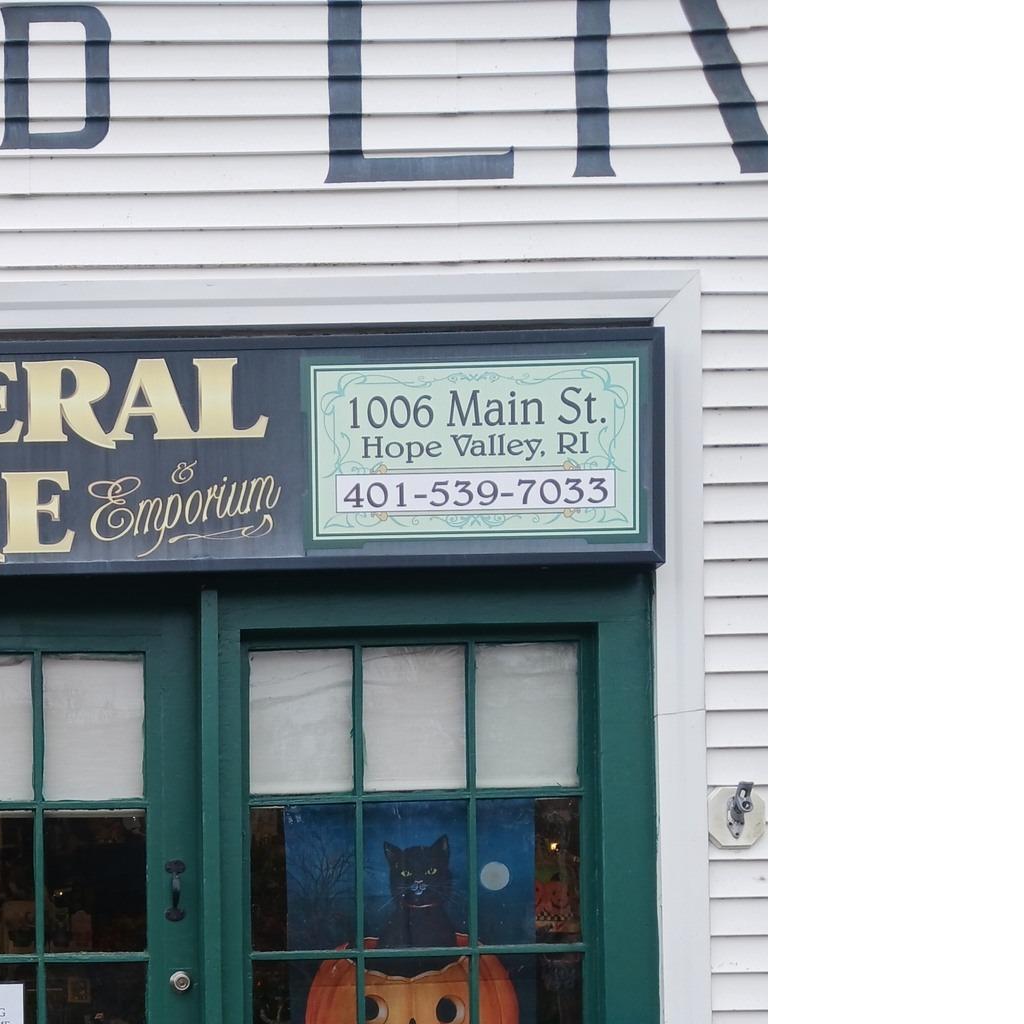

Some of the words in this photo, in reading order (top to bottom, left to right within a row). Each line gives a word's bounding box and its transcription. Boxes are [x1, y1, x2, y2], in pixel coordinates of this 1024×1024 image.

[349, 394, 434, 429] 1006
[446, 389, 544, 427] Main
[557, 386, 607, 425] St.
[361, 435, 443, 463] Hope
[450, 433, 546, 461] Valley,
[557, 431, 589, 455] RI
[171, 459, 198, 485] &
[343, 477, 609, 508] 401-539-7033
[87, 474, 282, 558] Emporium
